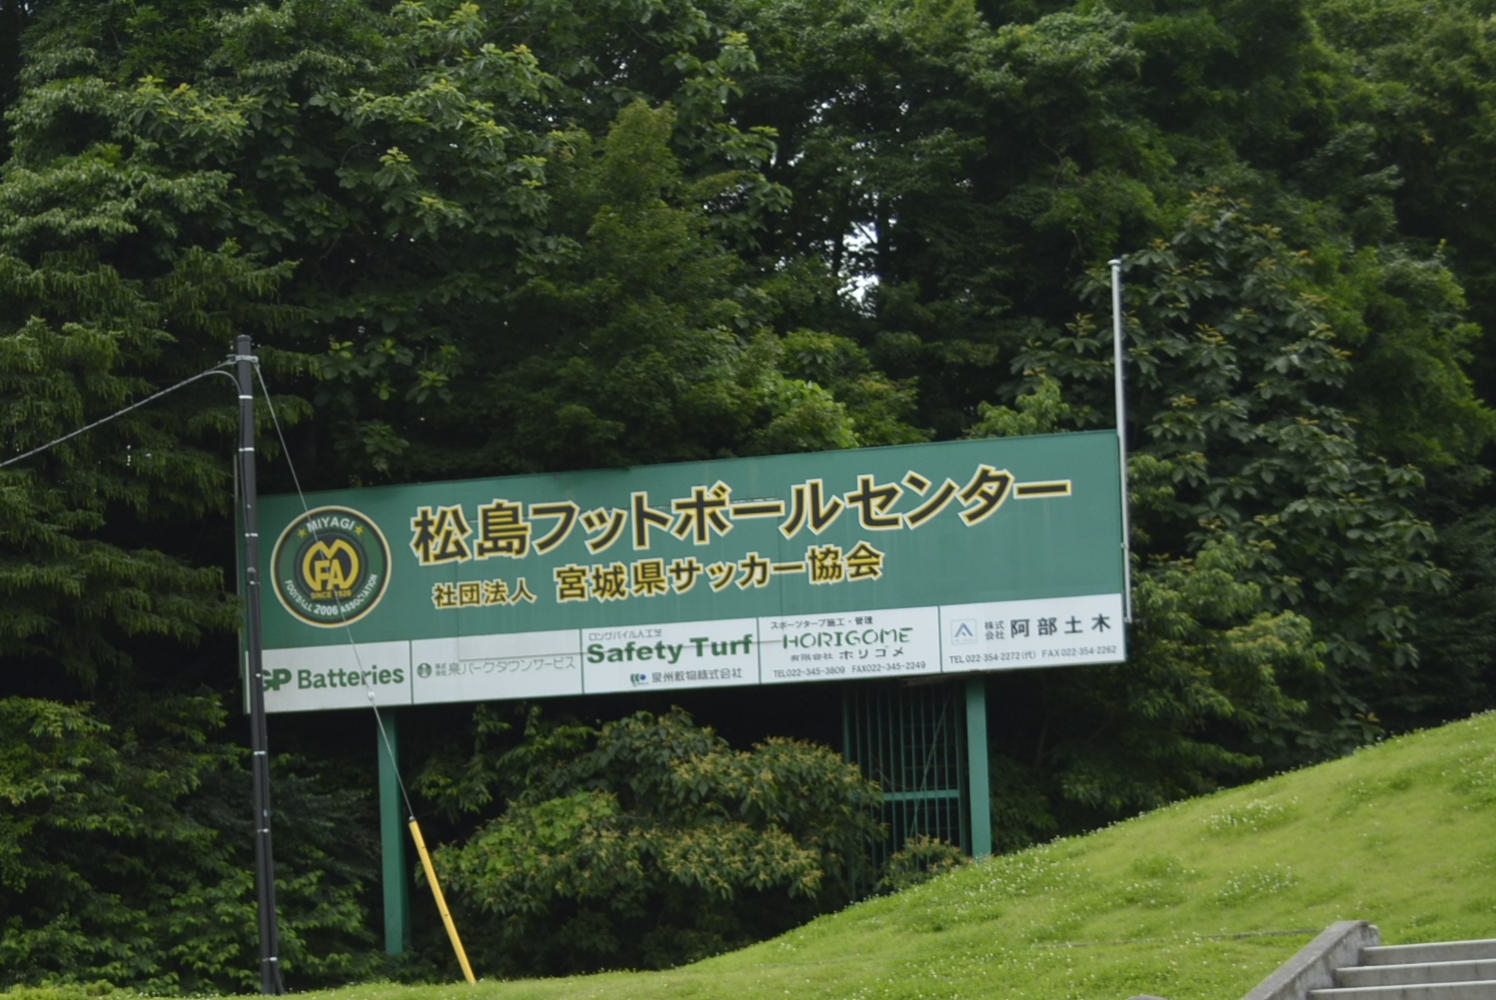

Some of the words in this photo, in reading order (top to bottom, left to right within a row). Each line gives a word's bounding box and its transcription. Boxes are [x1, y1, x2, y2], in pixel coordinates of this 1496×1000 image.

[306, 516, 356, 533] MIYAGI
[410, 464, 1072, 566] 松島フットボールセンター
[432, 577, 537, 609] 社団法人
[554, 541, 885, 603] 宮城県サッカー協会
[313, 604, 339, 616] 2006
[782, 627, 914, 650] HORIGOME
[1010, 613, 1112, 639] 阿部土木
[586, 640, 684, 665] Safety
[689, 633, 753, 658] Turf
[297, 665, 405, 690] Batteries
